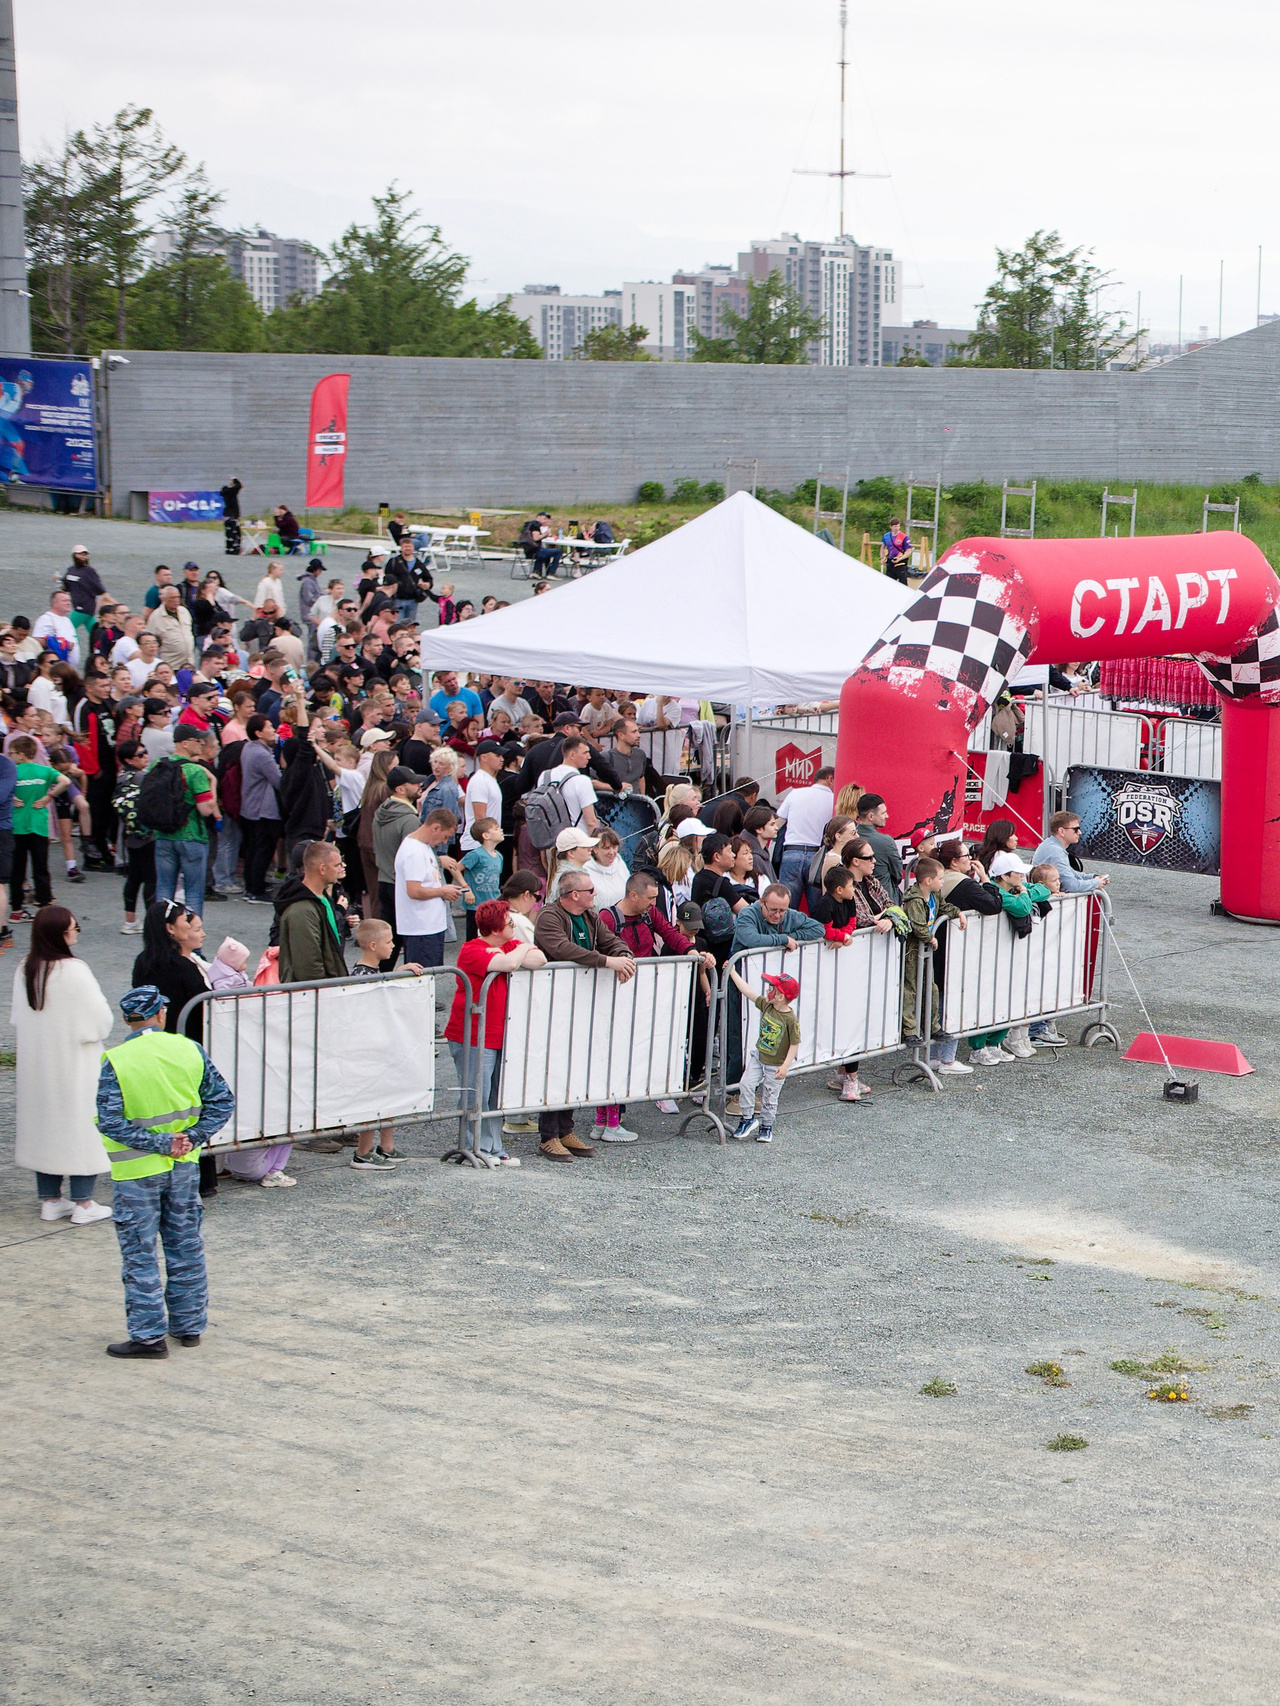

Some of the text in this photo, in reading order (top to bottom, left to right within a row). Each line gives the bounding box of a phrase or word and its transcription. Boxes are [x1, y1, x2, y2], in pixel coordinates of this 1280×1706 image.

[163, 500, 222, 511] СТАРТ
[1070, 568, 1238, 639] СТАРТ
[785, 756, 814, 780] МИР
[1126, 793, 1168, 805] FEDERATION
[1120, 800, 1171, 834] OSR
